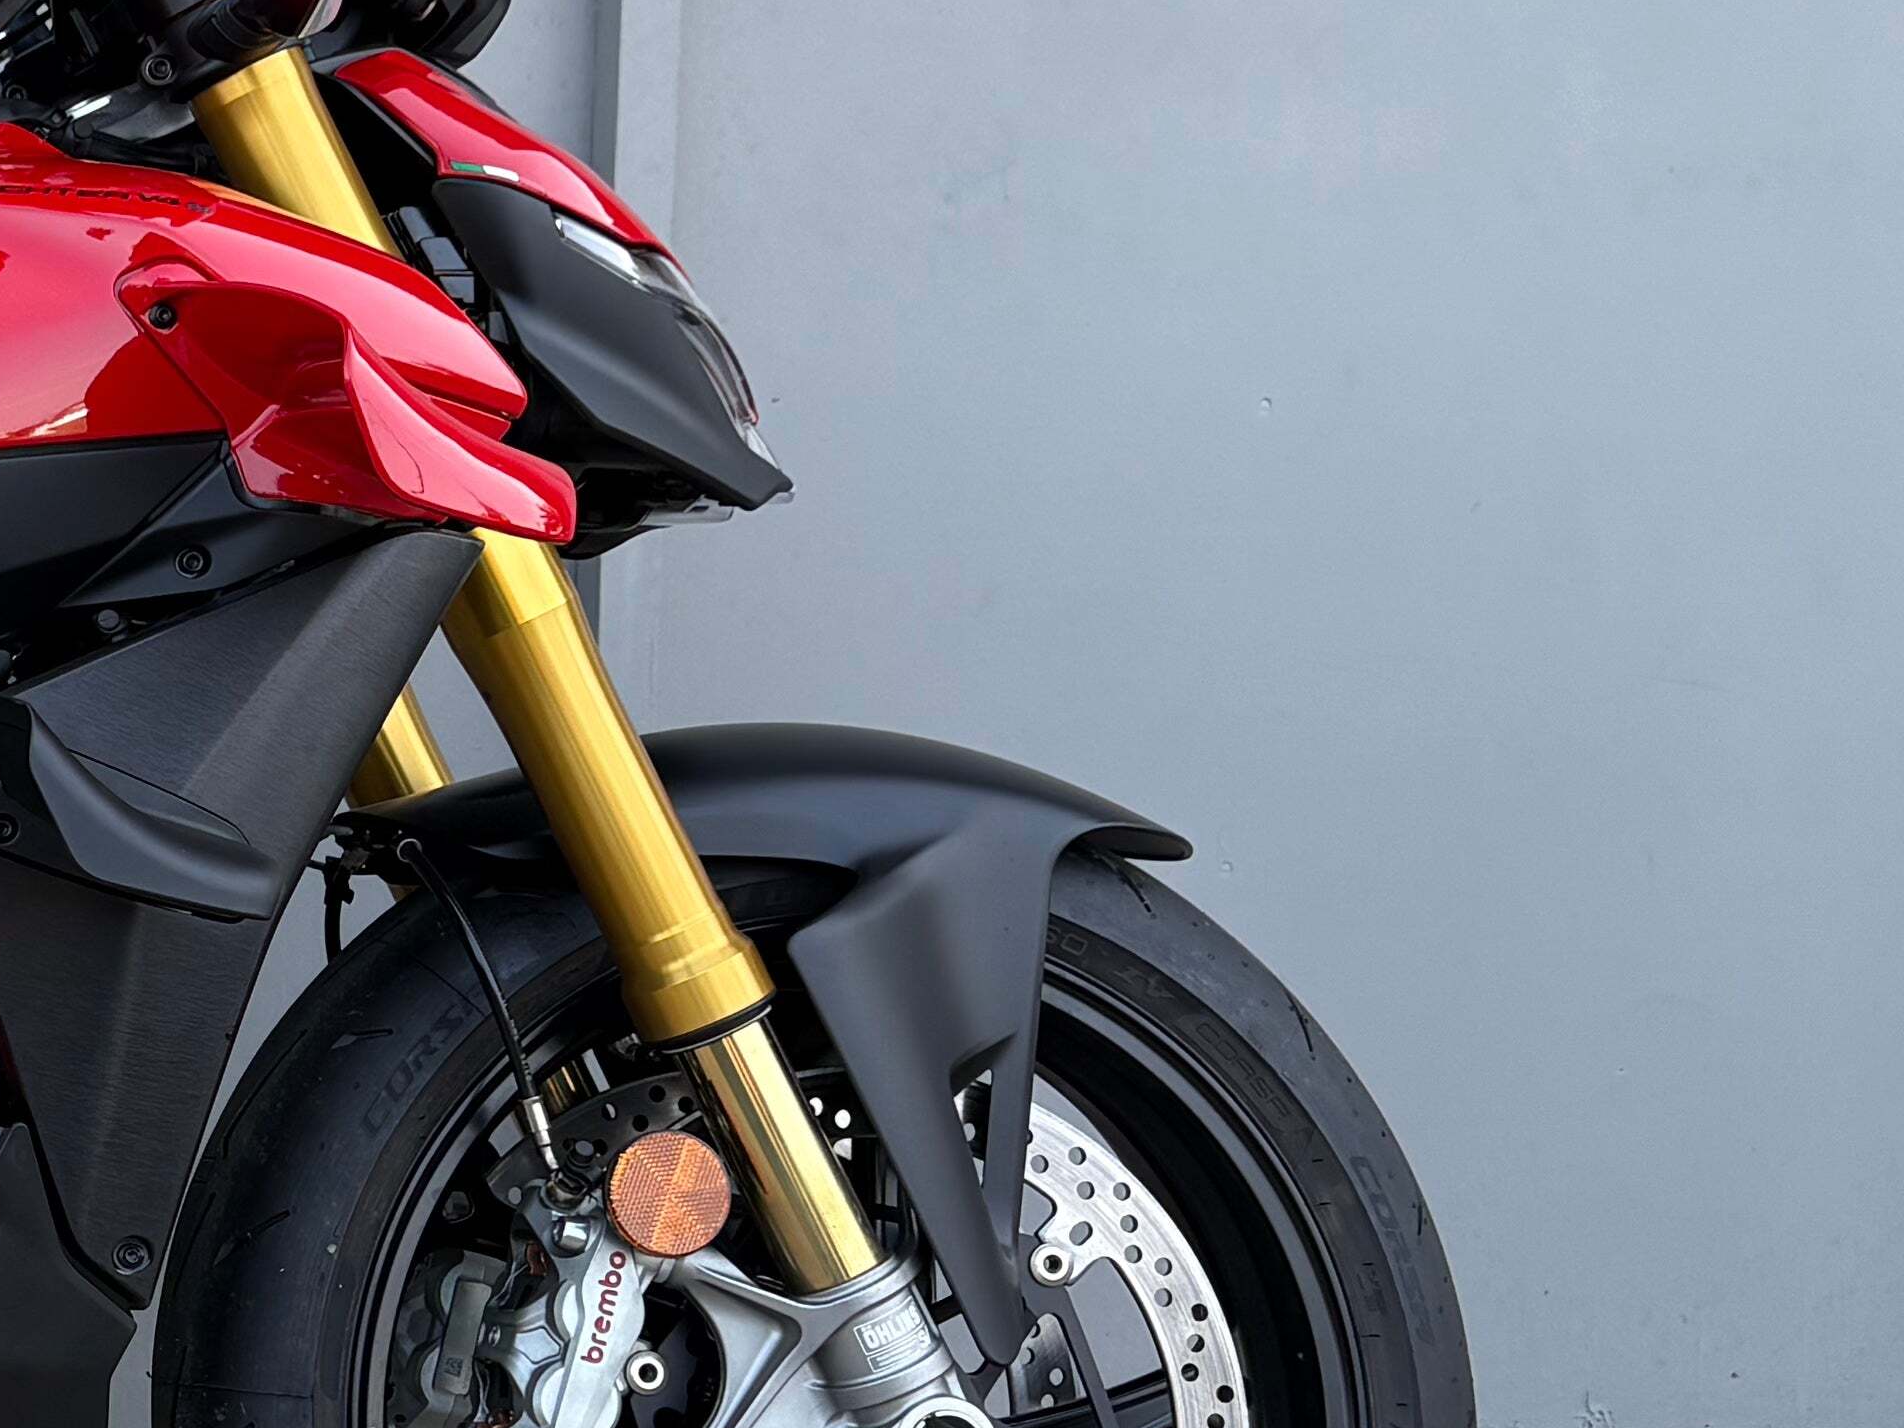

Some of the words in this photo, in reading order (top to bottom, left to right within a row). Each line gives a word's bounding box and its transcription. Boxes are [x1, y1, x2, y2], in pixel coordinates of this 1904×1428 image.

[1190, 1019, 1294, 1123] CORSA
[1347, 1150, 1436, 1349] CORSA
[580, 1251, 626, 1364] brembo
[860, 1303, 921, 1349] ÖHLINS
